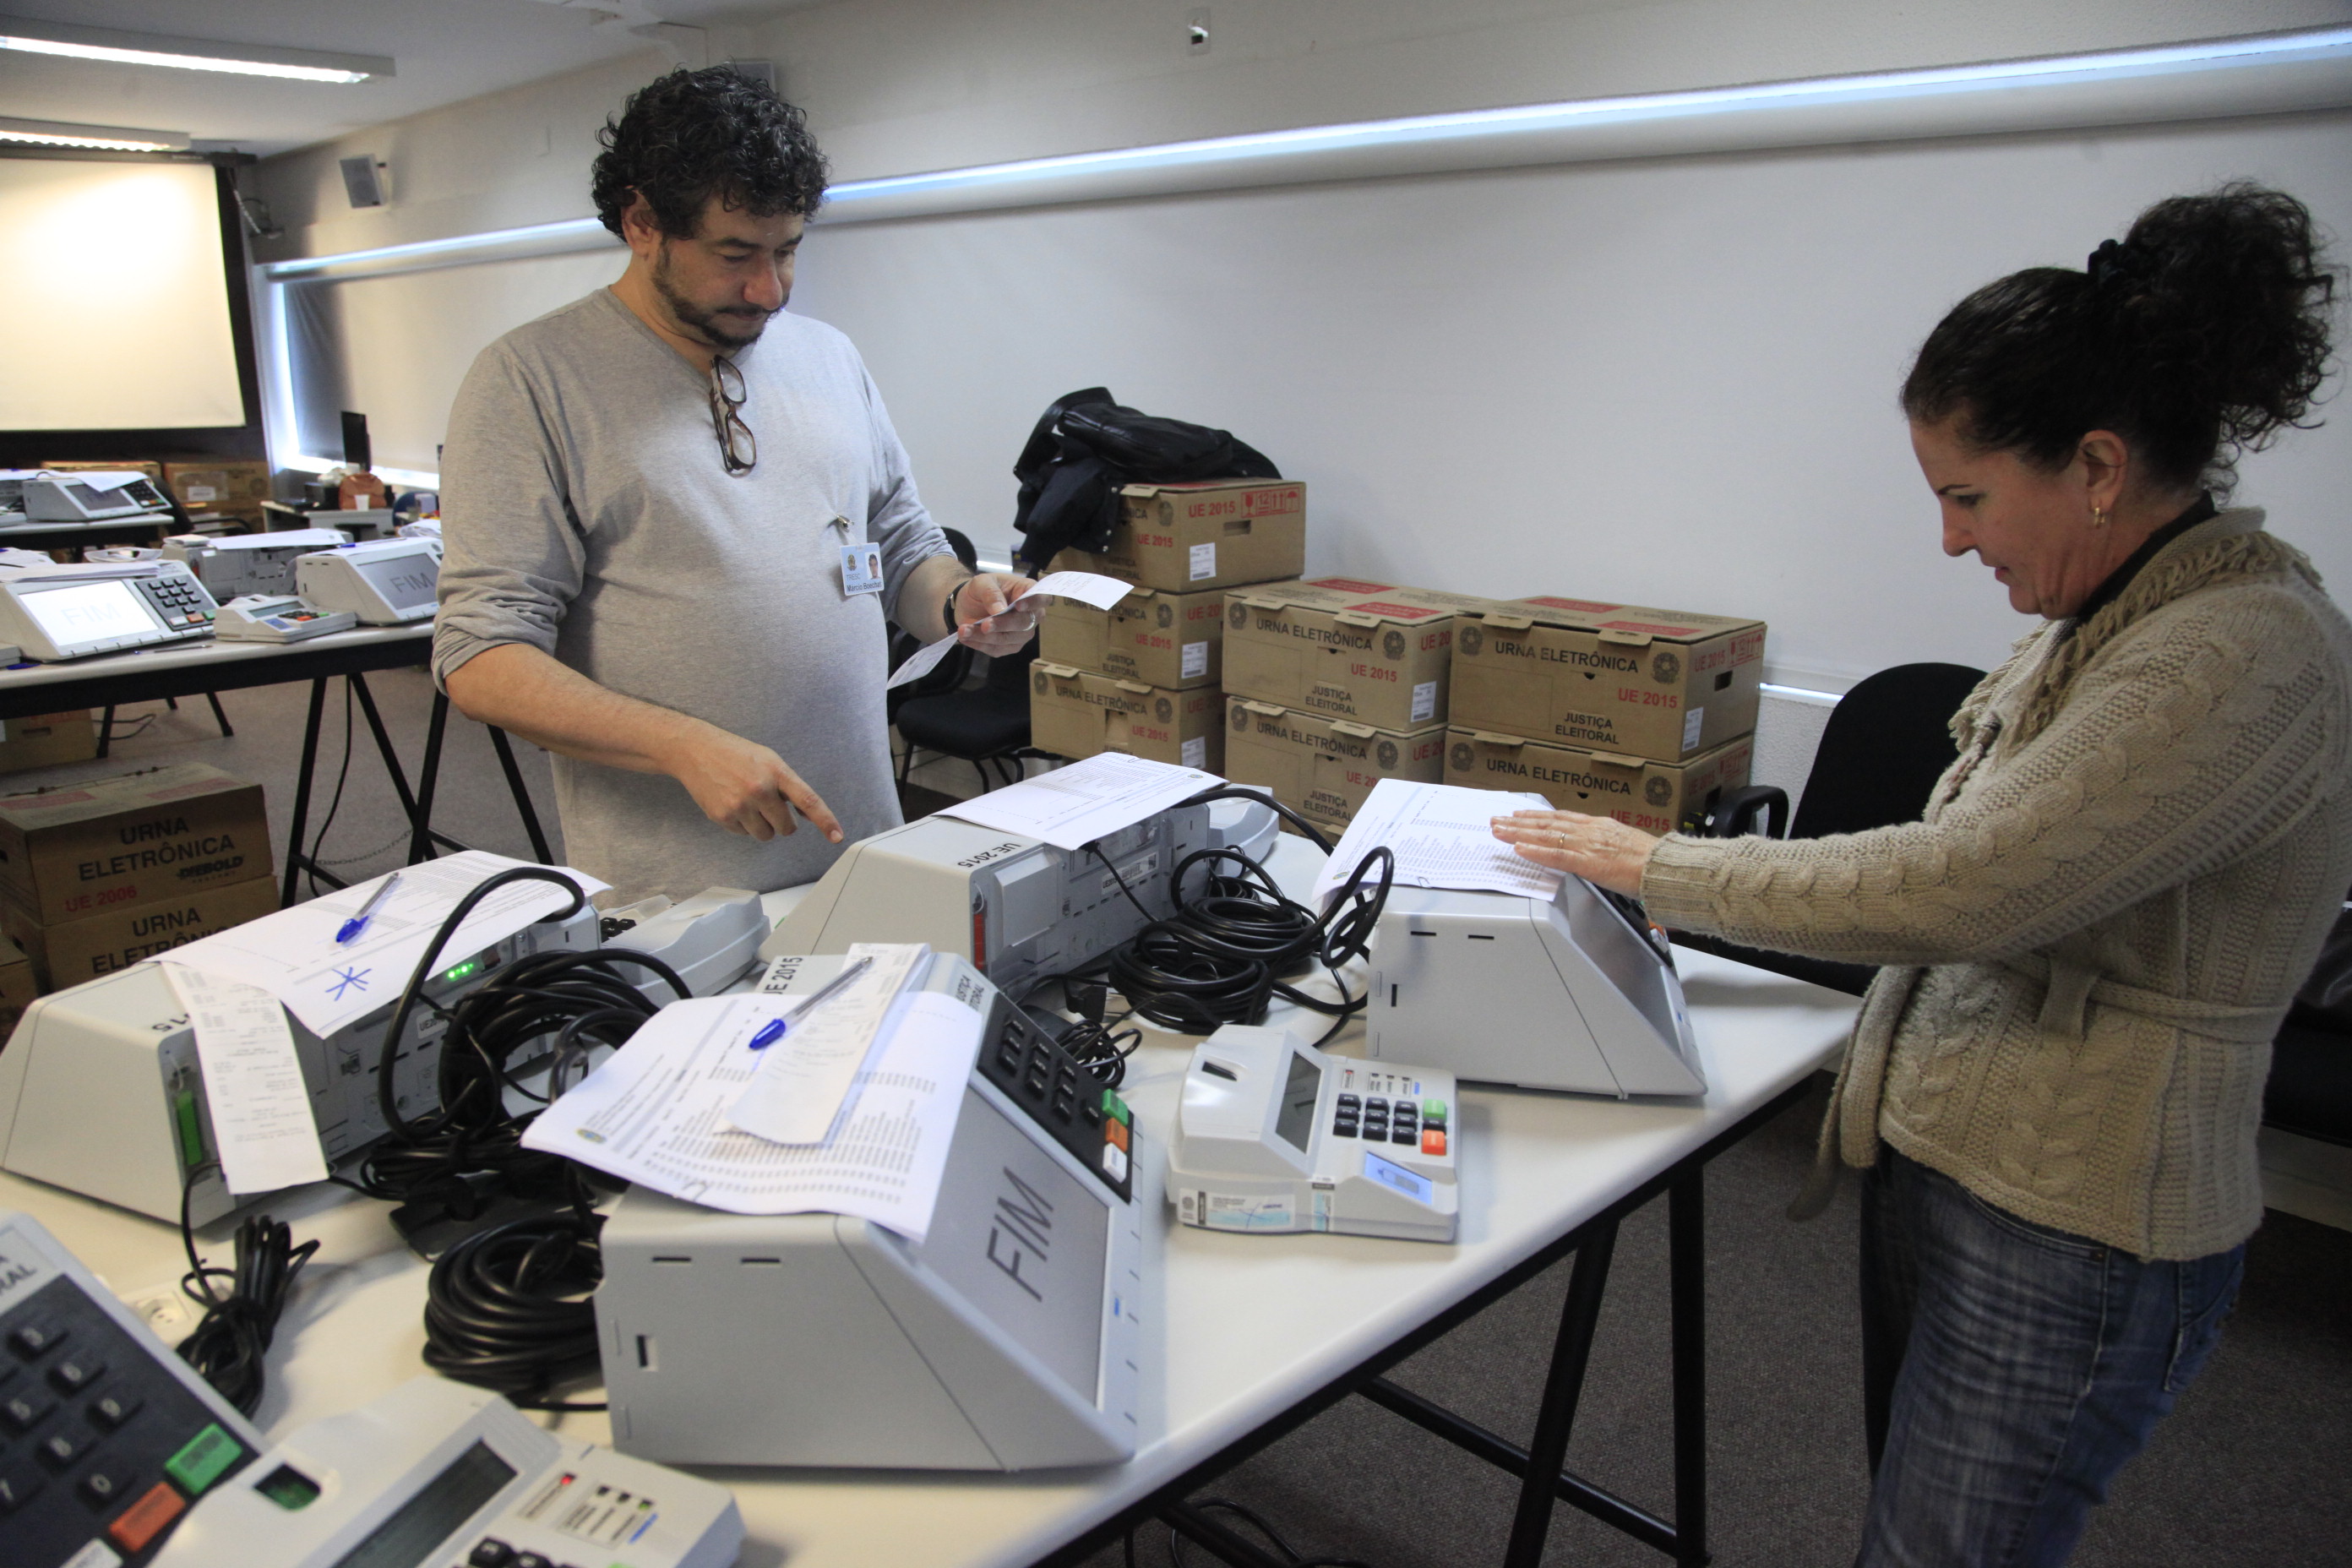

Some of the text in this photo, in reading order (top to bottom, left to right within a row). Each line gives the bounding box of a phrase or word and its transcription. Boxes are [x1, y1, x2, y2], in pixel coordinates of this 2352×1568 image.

[1189, 501, 1236, 518] UE 2015
[1137, 534, 1173, 547] UE 2015
[389, 573, 434, 592] FIM
[61, 602, 122, 625] FIM
[1090, 600, 1146, 621] ERÔNICA
[1188, 604, 1223, 620] UE 20
[1136, 634, 1172, 650] UE 2015
[1256, 618, 1373, 651] URNA ELETRÔNICA
[1421, 632, 1451, 651] UE 20
[1106, 653, 1135, 667] JUSTIÇA
[1495, 641, 1638, 673] URNA ELETRÔNICA
[1694, 650, 1725, 672] UE 2015
[1102, 663, 1140, 678] ELEITORAL
[1352, 663, 1397, 683] UE 2015
[1056, 687, 1147, 715] URNA ELETRÔNICA
[1312, 686, 1352, 702] JUSTIÇA
[1619, 688, 1678, 709] UE 2015
[1305, 696, 1358, 716] ELEITORAL
[1565, 712, 1612, 729] JUSTIÇA
[1132, 725, 1169, 742] UE 2015
[1257, 721, 1367, 760] URNA ELETRÔNICA
[1555, 725, 1620, 744] ELEITORAL
[1413, 742, 1445, 760] UE 20
[1347, 770, 1378, 787] UE 20
[1487, 760, 1631, 795] URNA ELETRÔNICA
[1309, 790, 1348, 808] JUSTIÇA
[1304, 800, 1352, 822] ELEITORAL
[1610, 809, 1669, 831] UE 2015
[120, 817, 189, 845] URNA
[79, 835, 235, 881] ELETRÔNICA
[958, 842, 1021, 868] UE 2015
[177, 855, 245, 879] DIEBOLD
[65, 896, 91, 912] UE
[133, 907, 202, 937] URNA
[92, 921, 241, 974] ELETRÔ
[771, 957, 803, 980] 2015
[956, 974, 971, 1002] USTIÇA
[988, 1166, 1054, 1302] FIM
